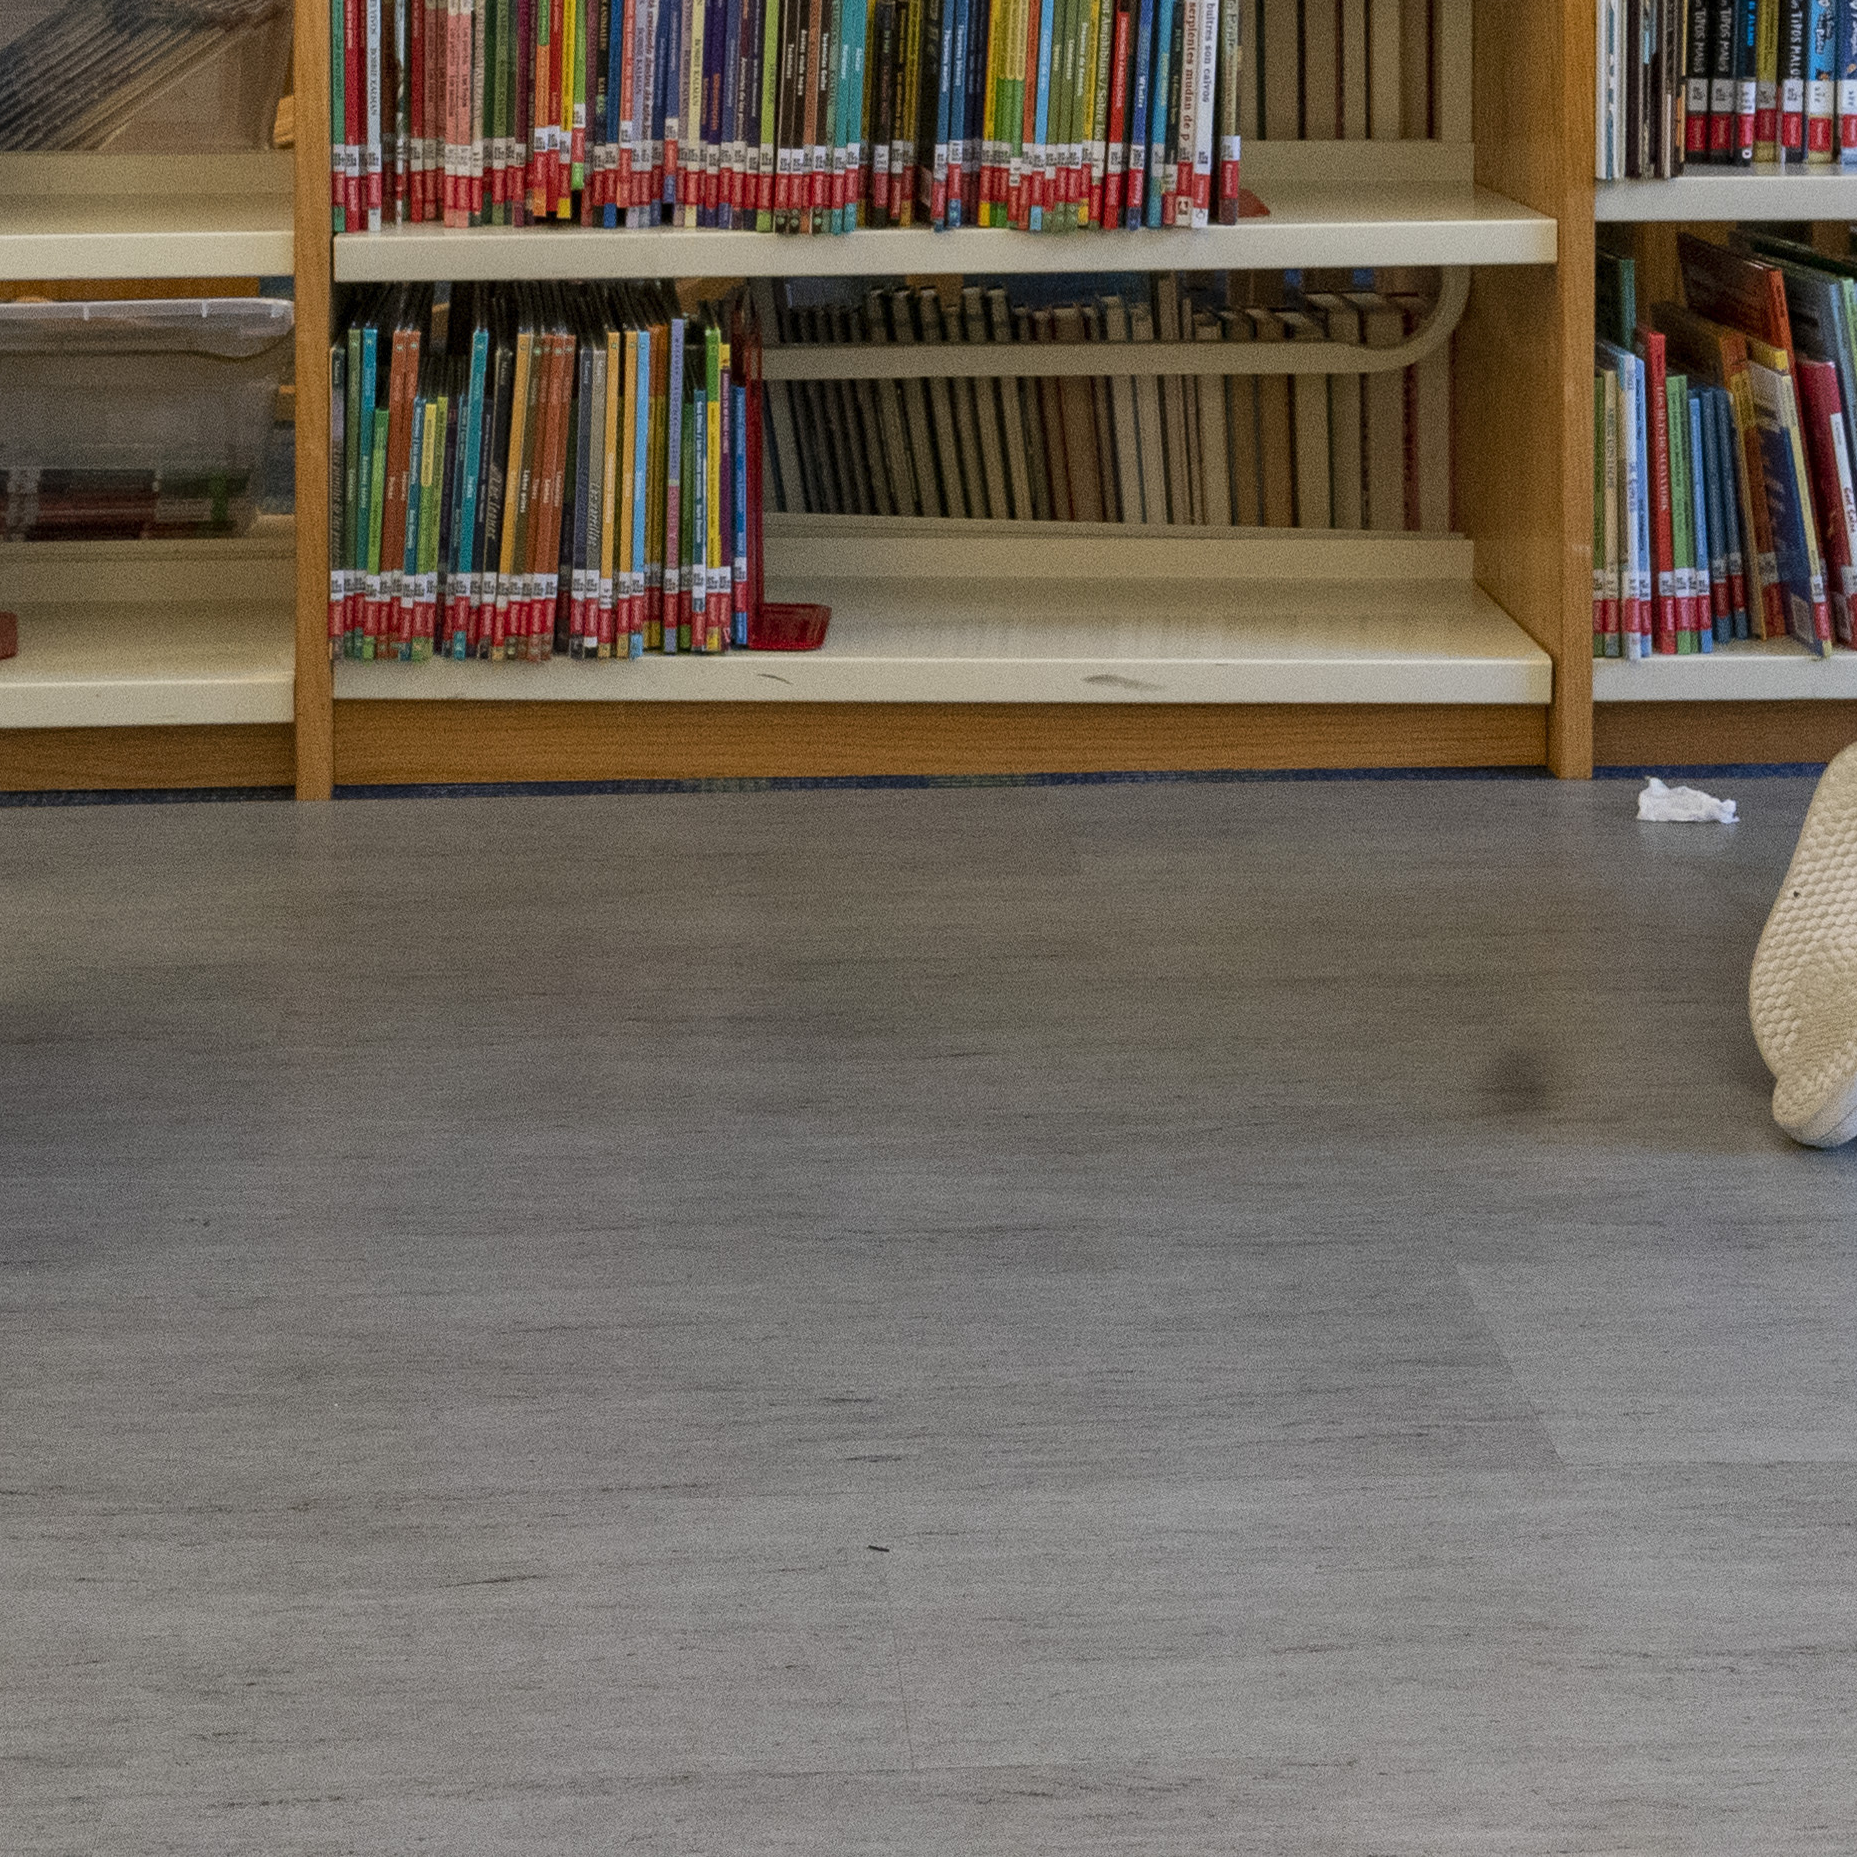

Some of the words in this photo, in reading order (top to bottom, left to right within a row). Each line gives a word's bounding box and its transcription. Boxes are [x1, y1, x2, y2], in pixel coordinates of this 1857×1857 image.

[1183, 1, 1198, 66] serpientes
[1204, 2, 1216, 47] buitres
[1790, 12, 1803, 42] TIPOS
[1203, 50, 1213, 71] son
[1183, 68, 1194, 106] mudan
[1201, 74, 1213, 103] calvos
